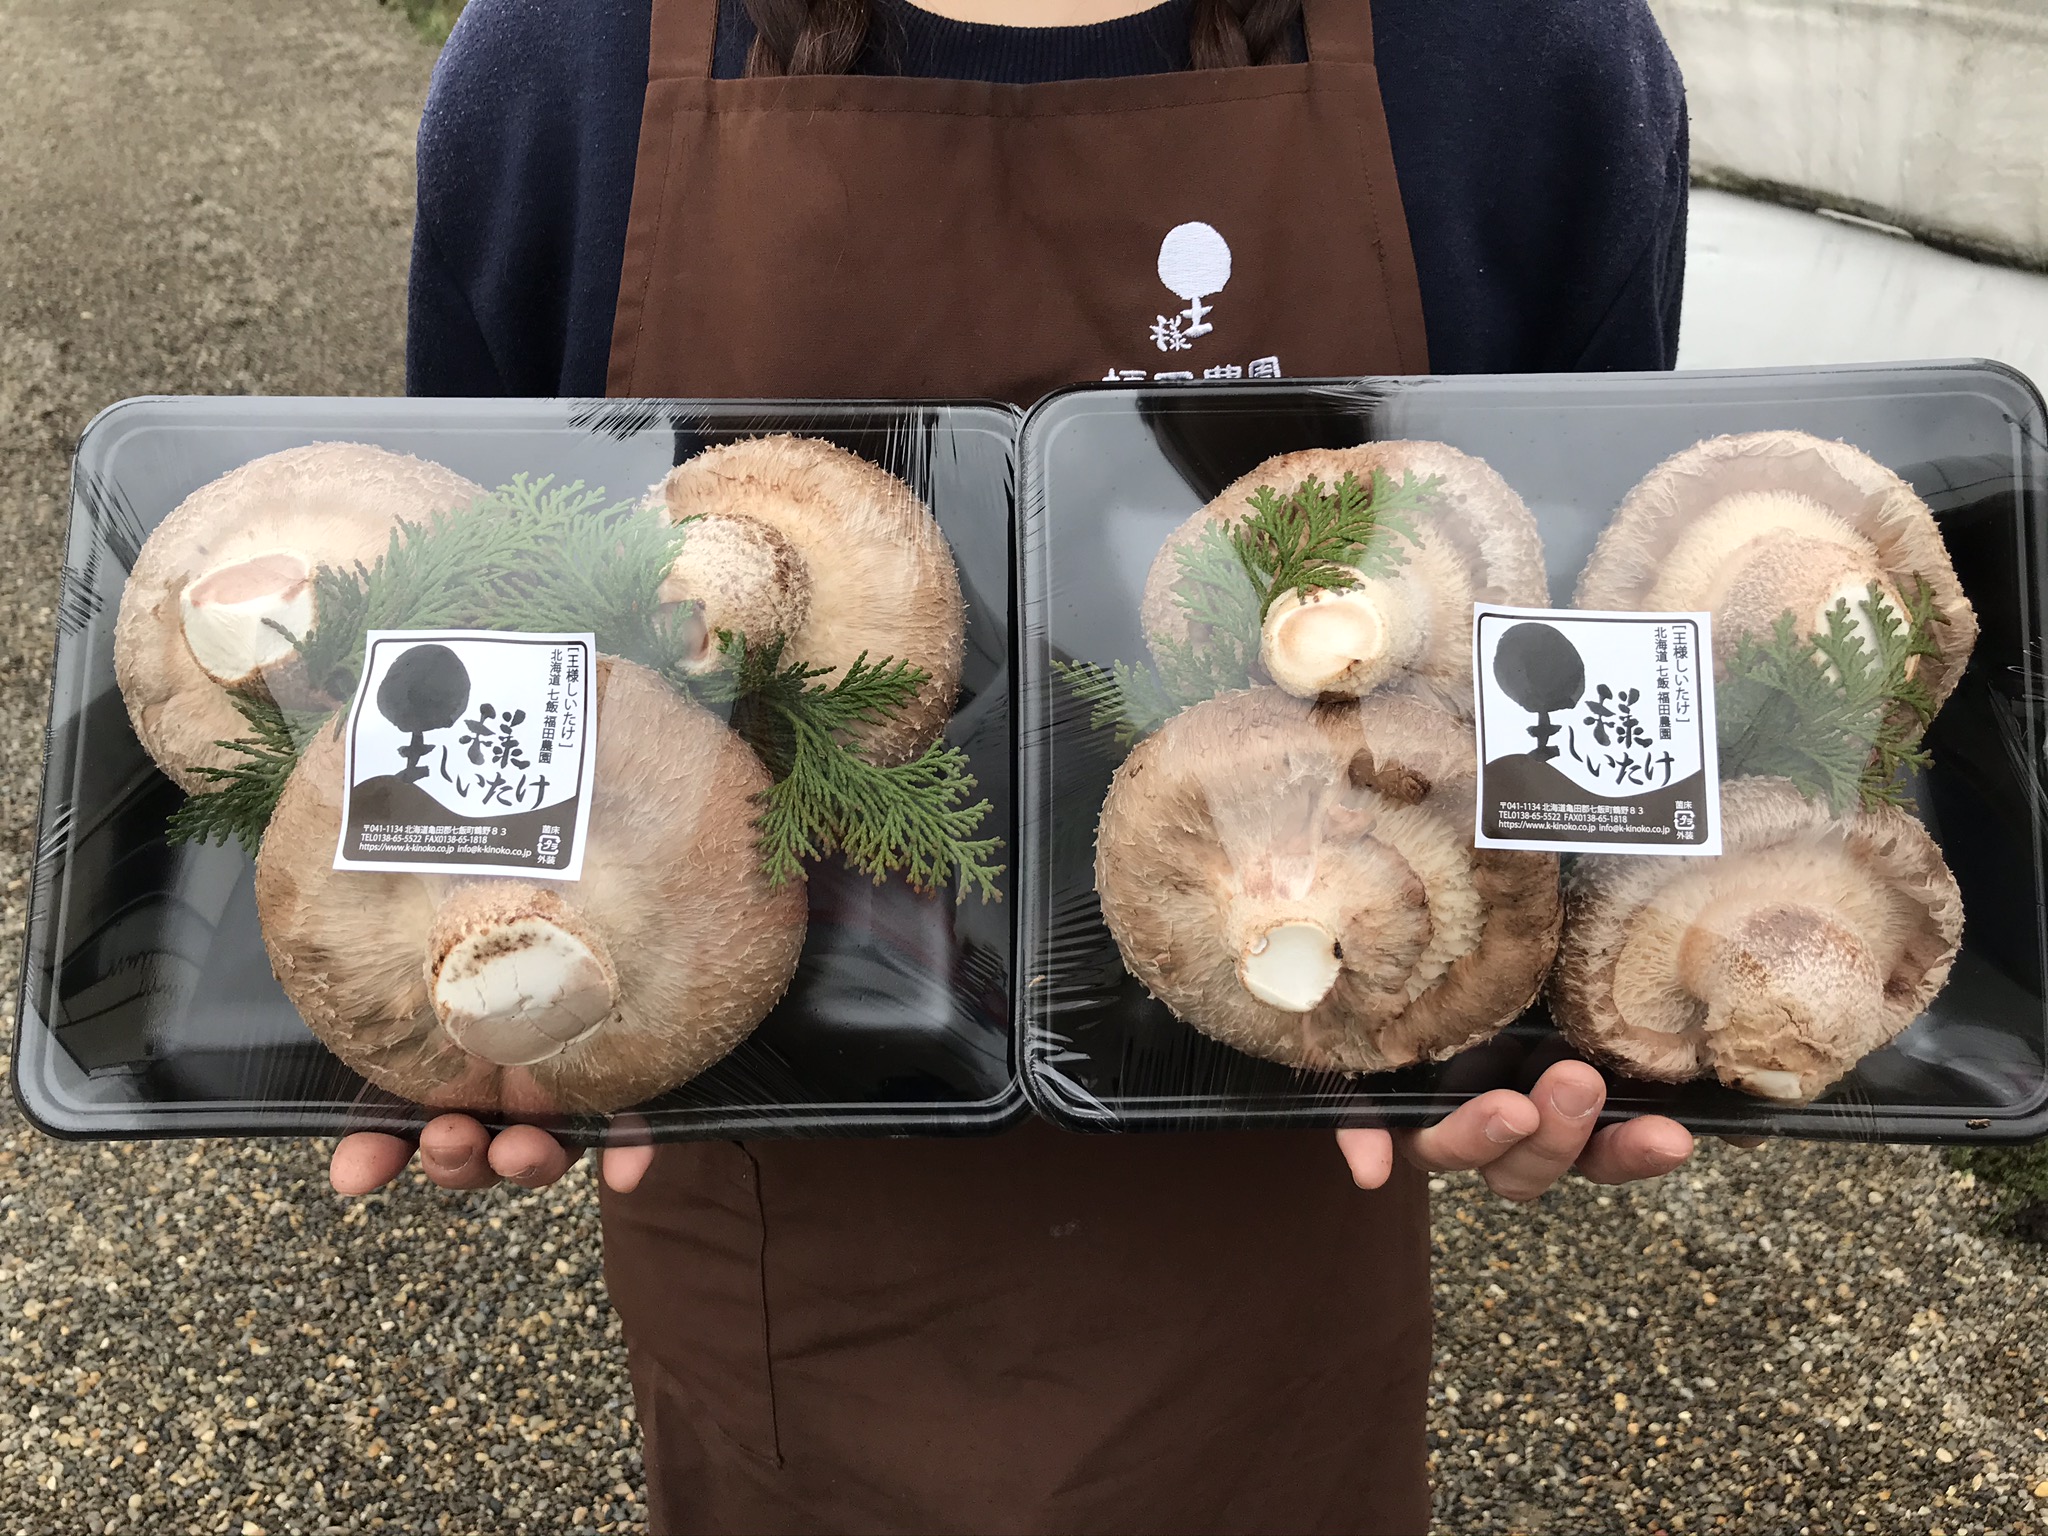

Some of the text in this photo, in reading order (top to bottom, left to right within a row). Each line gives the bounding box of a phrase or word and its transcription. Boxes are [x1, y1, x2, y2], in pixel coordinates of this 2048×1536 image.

[1654, 626, 1672, 740] 北海道 七飯 福田農園
[538, 648, 563, 764] 北海道 七飯 福田農園
[1498, 811, 1628, 824] TEL0138-65-5522 FAX0138-65-1818
[1498, 820, 1671, 835] https://www.k-kinoko.co.jp info@k-kinoko.co.jp
[361, 833, 488, 845] TEL0138-65-5522 FAX0138-65-1818
[1676, 831, 1694, 840] 外装
[358, 842, 532, 858] https://www.k-kinoko.co.jp info@k-kinoko.co.jp
[536, 854, 556, 865] 外装
